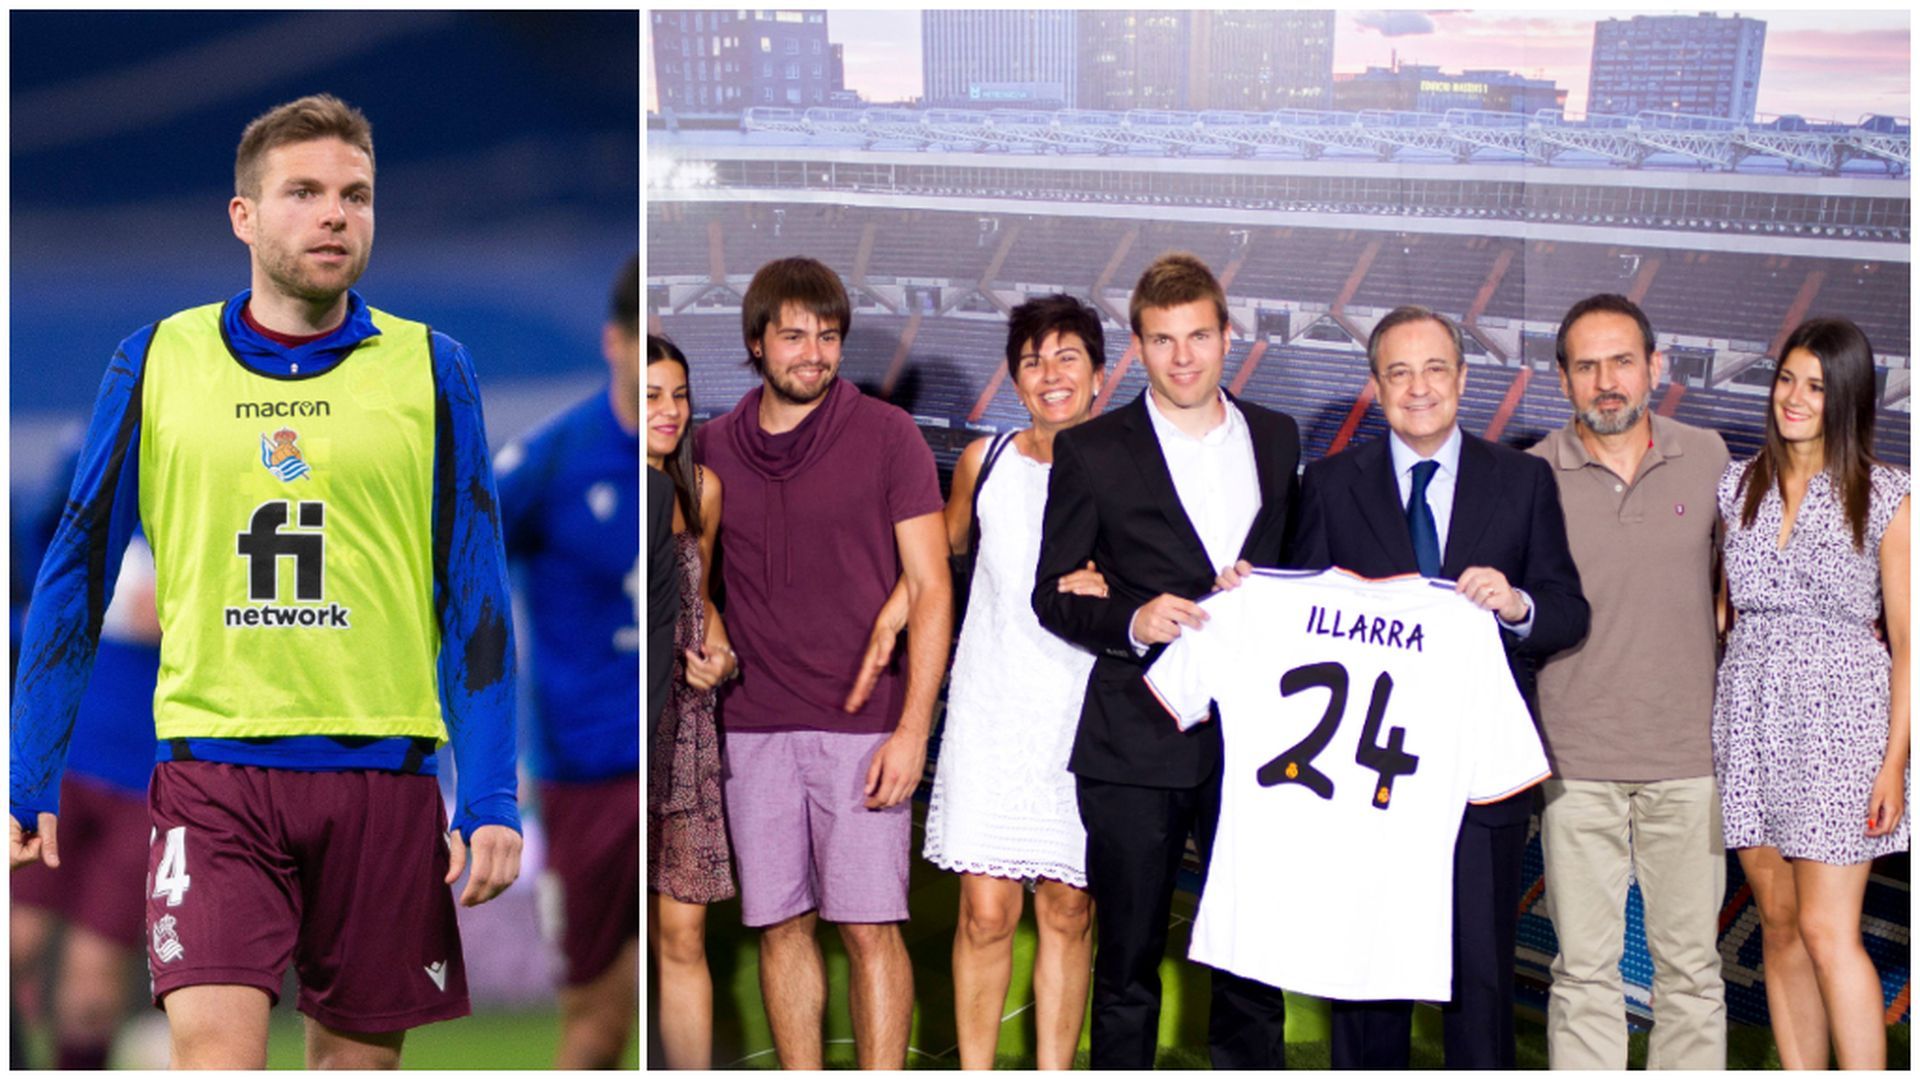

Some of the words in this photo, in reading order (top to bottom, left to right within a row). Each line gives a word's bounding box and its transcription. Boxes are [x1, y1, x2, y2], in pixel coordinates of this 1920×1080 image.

[235, 400, 331, 418] macron
[237, 501, 324, 601] fi
[225, 604, 348, 627] network
[1306, 605, 1425, 653] ILLARRA
[1256, 661, 1420, 810] 24
[149, 825, 191, 907] 4
